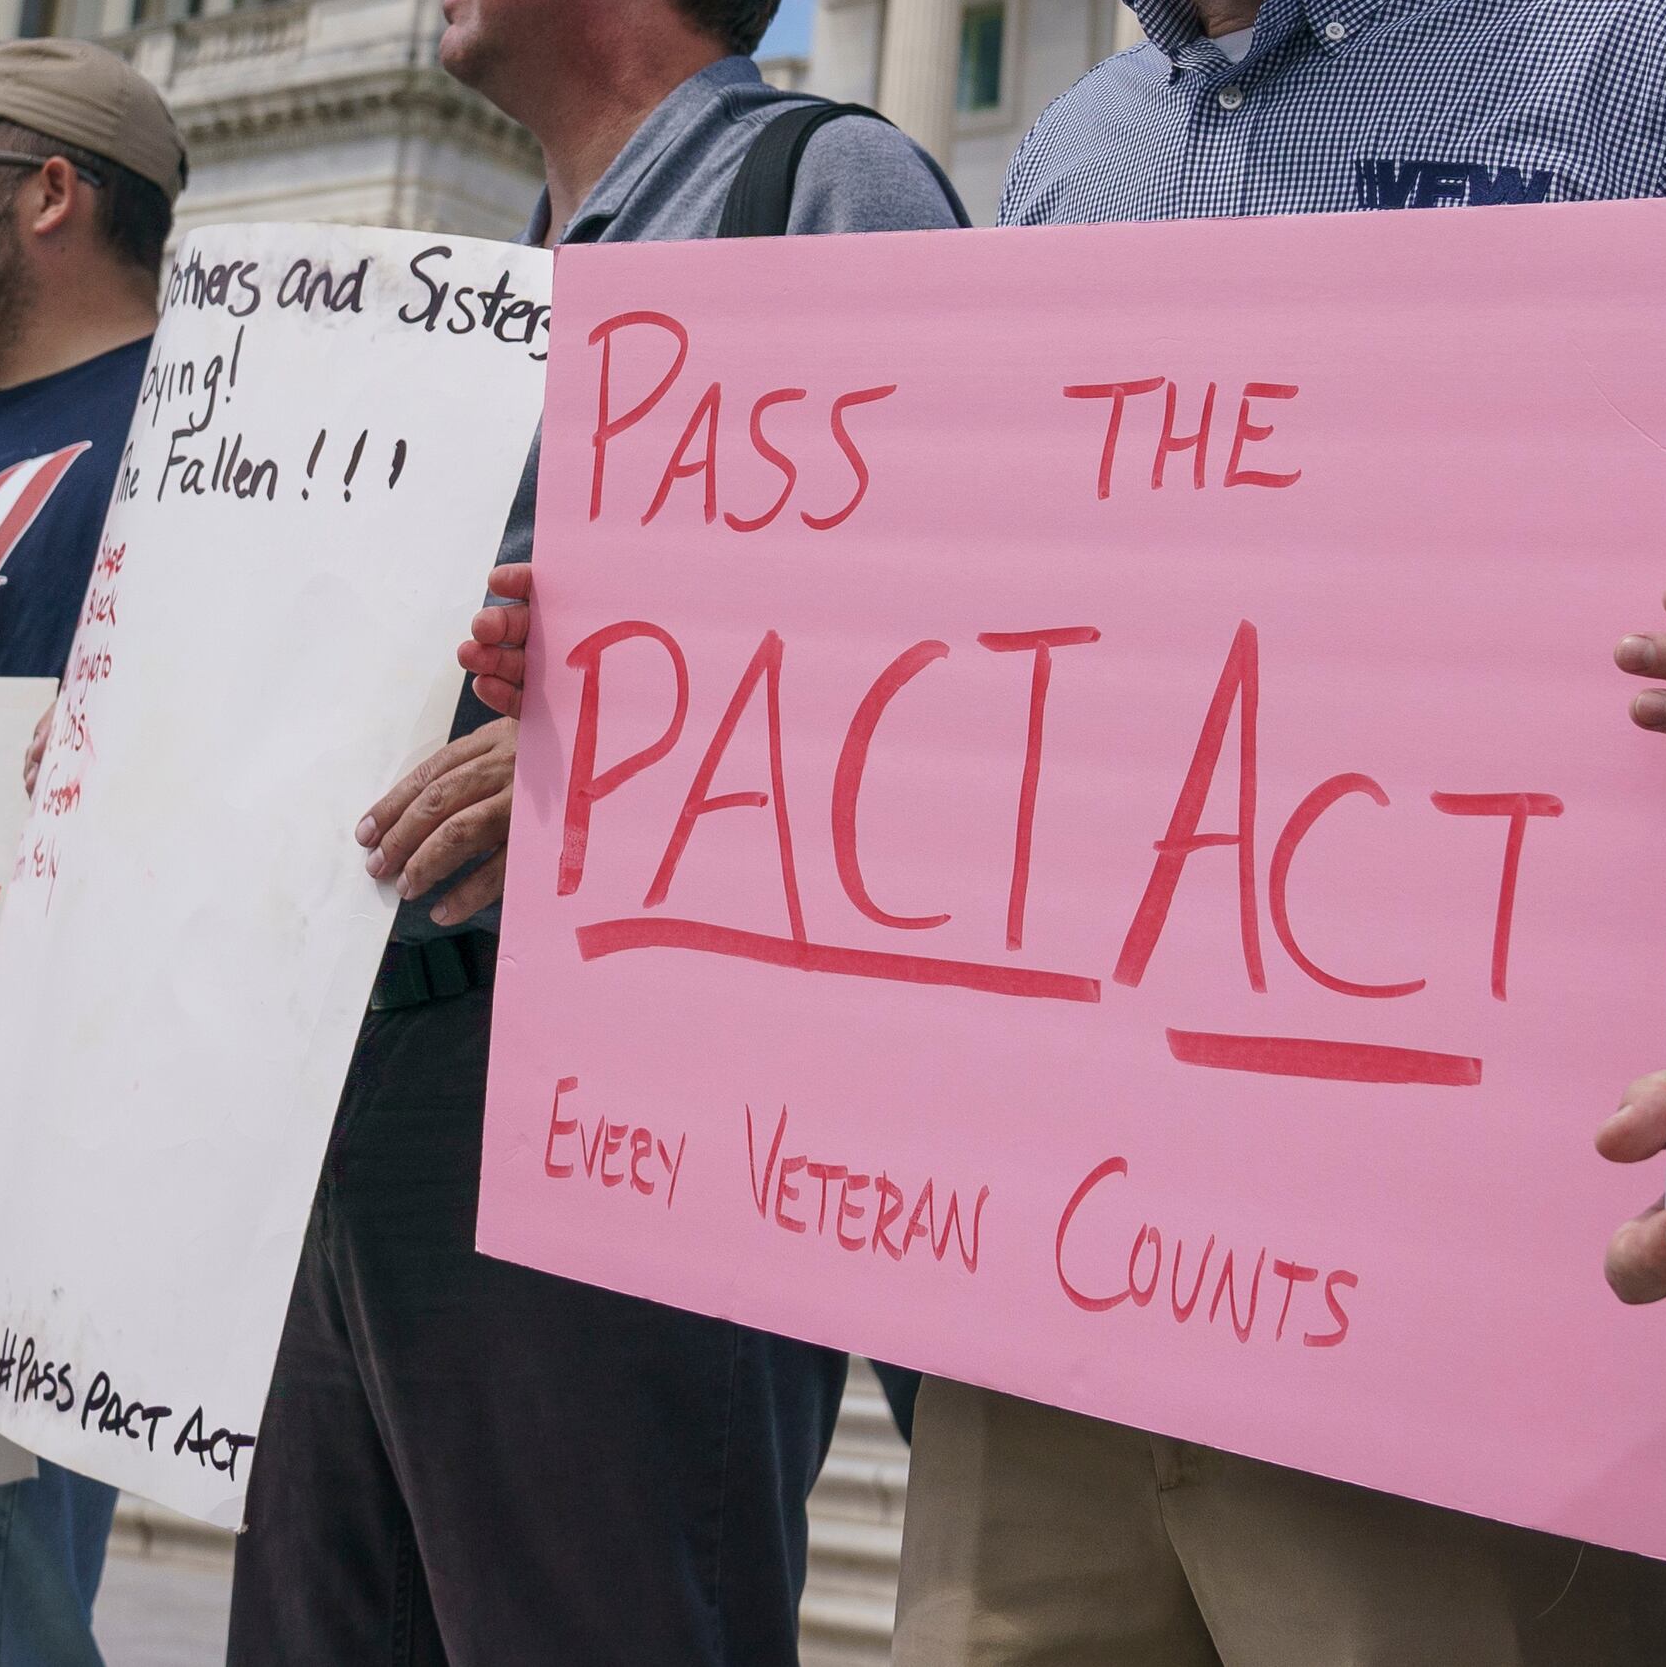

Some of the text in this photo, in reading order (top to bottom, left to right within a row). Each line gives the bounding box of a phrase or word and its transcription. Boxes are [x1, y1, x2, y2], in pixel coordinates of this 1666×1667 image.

[141, 325, 245, 432] dying!
[163, 245, 552, 361] rothers and Sisters
[587, 310, 1302, 533] PASS THE
[556, 618, 1564, 1002] PACT ACT
[544, 1075, 1359, 1348] EVERY VETERAN COUNTS
[81, 1371, 173, 1452] PACT
